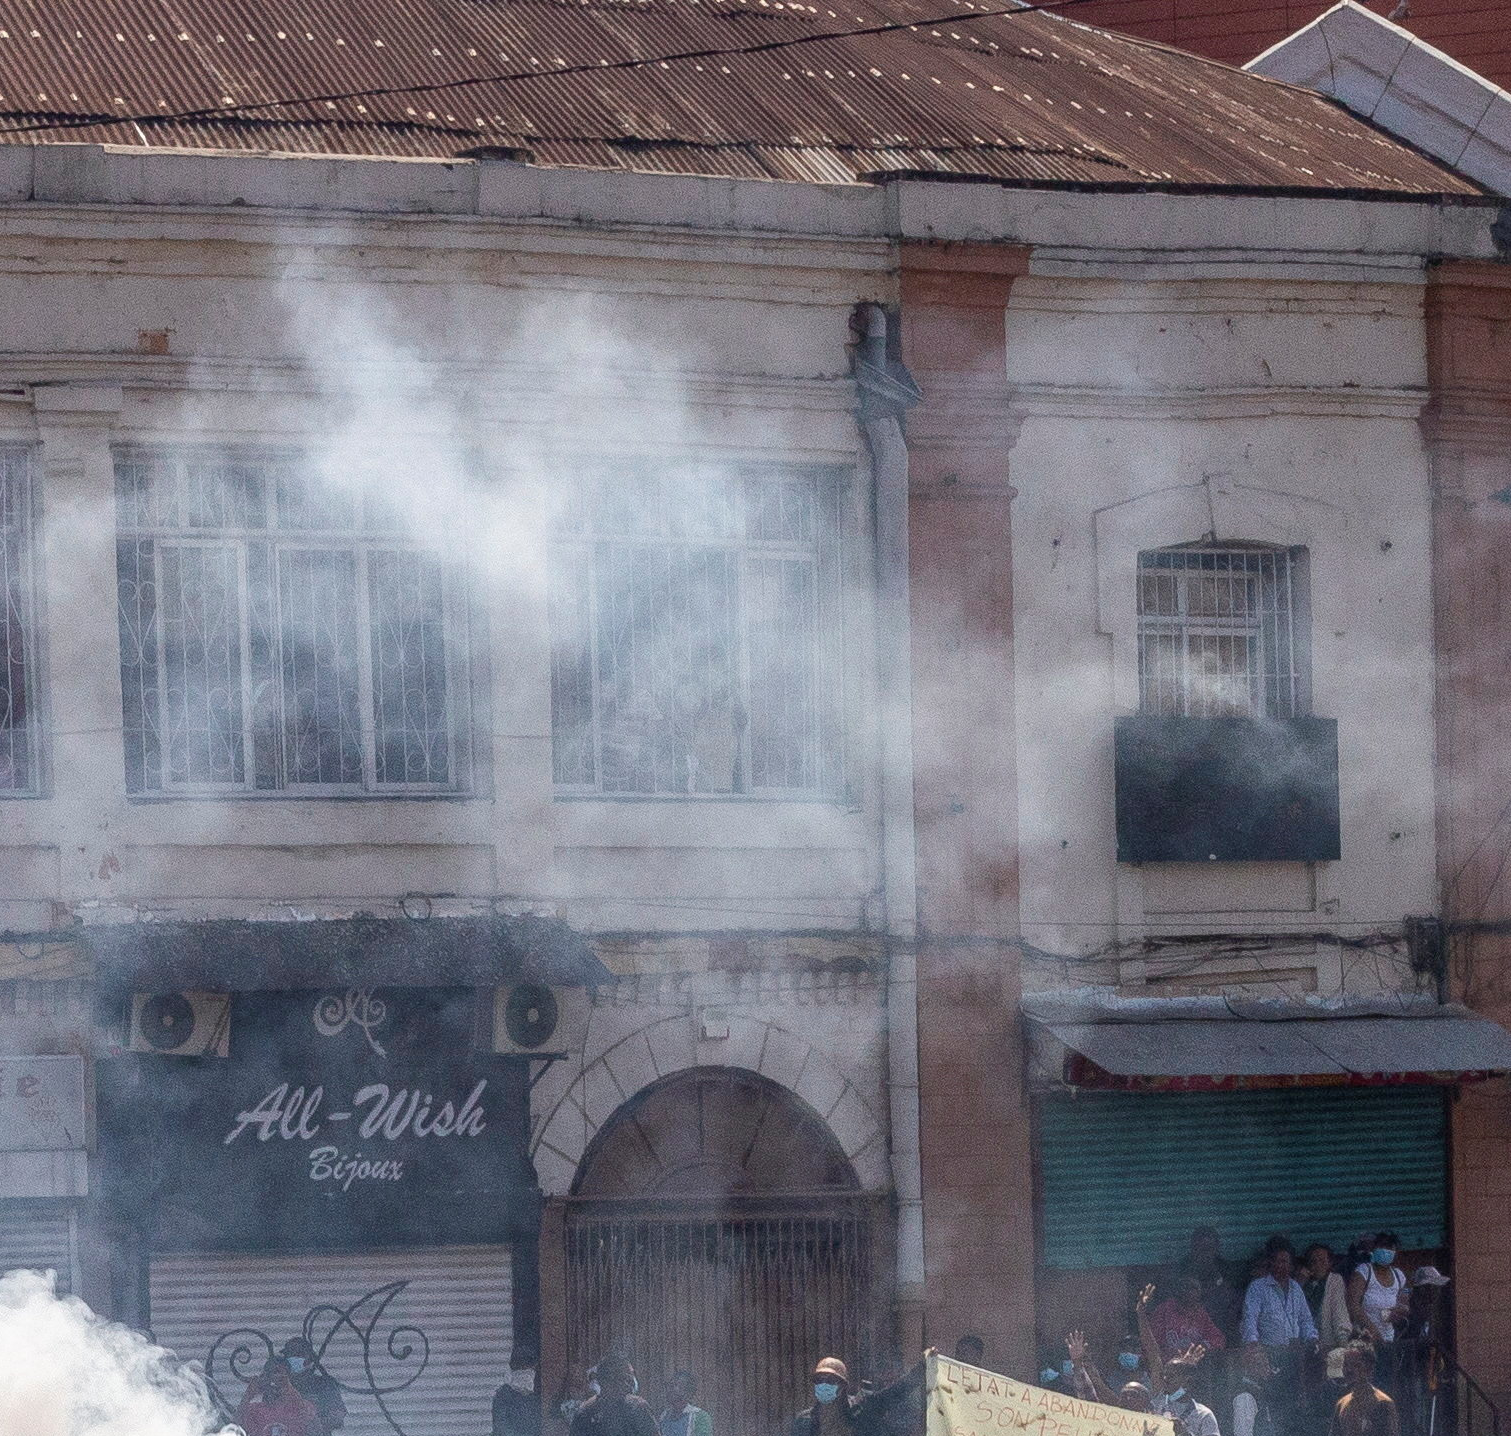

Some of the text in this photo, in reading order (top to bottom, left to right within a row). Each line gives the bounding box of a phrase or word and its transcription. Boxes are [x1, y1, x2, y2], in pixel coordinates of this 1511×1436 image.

[308, 1146, 404, 1192] Bijoux
[1021, 1388, 1032, 1405] A
[976, 1400, 1030, 1429] SON
